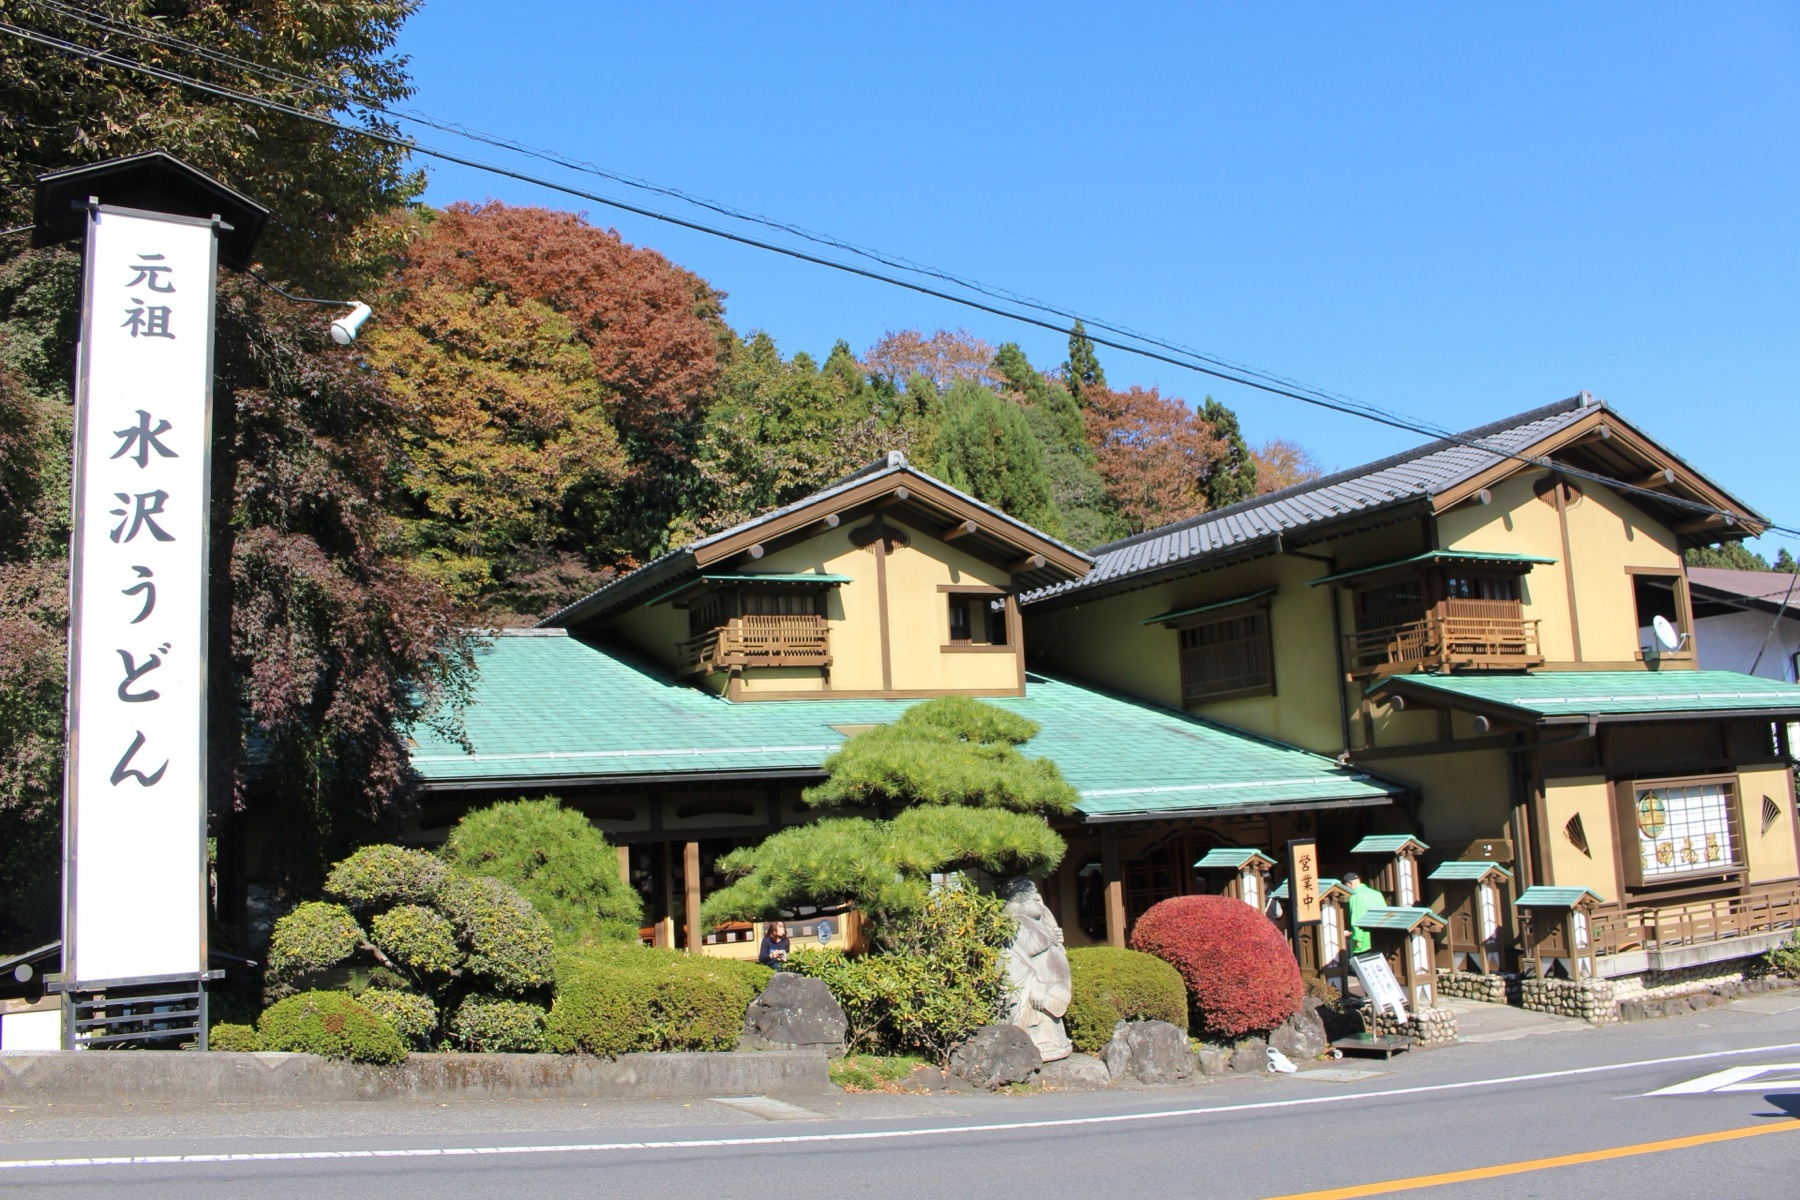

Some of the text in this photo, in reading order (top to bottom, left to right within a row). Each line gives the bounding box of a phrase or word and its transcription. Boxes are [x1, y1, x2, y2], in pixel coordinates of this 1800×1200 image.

[109, 254, 180, 787] 元祖 水沢うどん
[1299, 854, 1314, 911] 営業中
